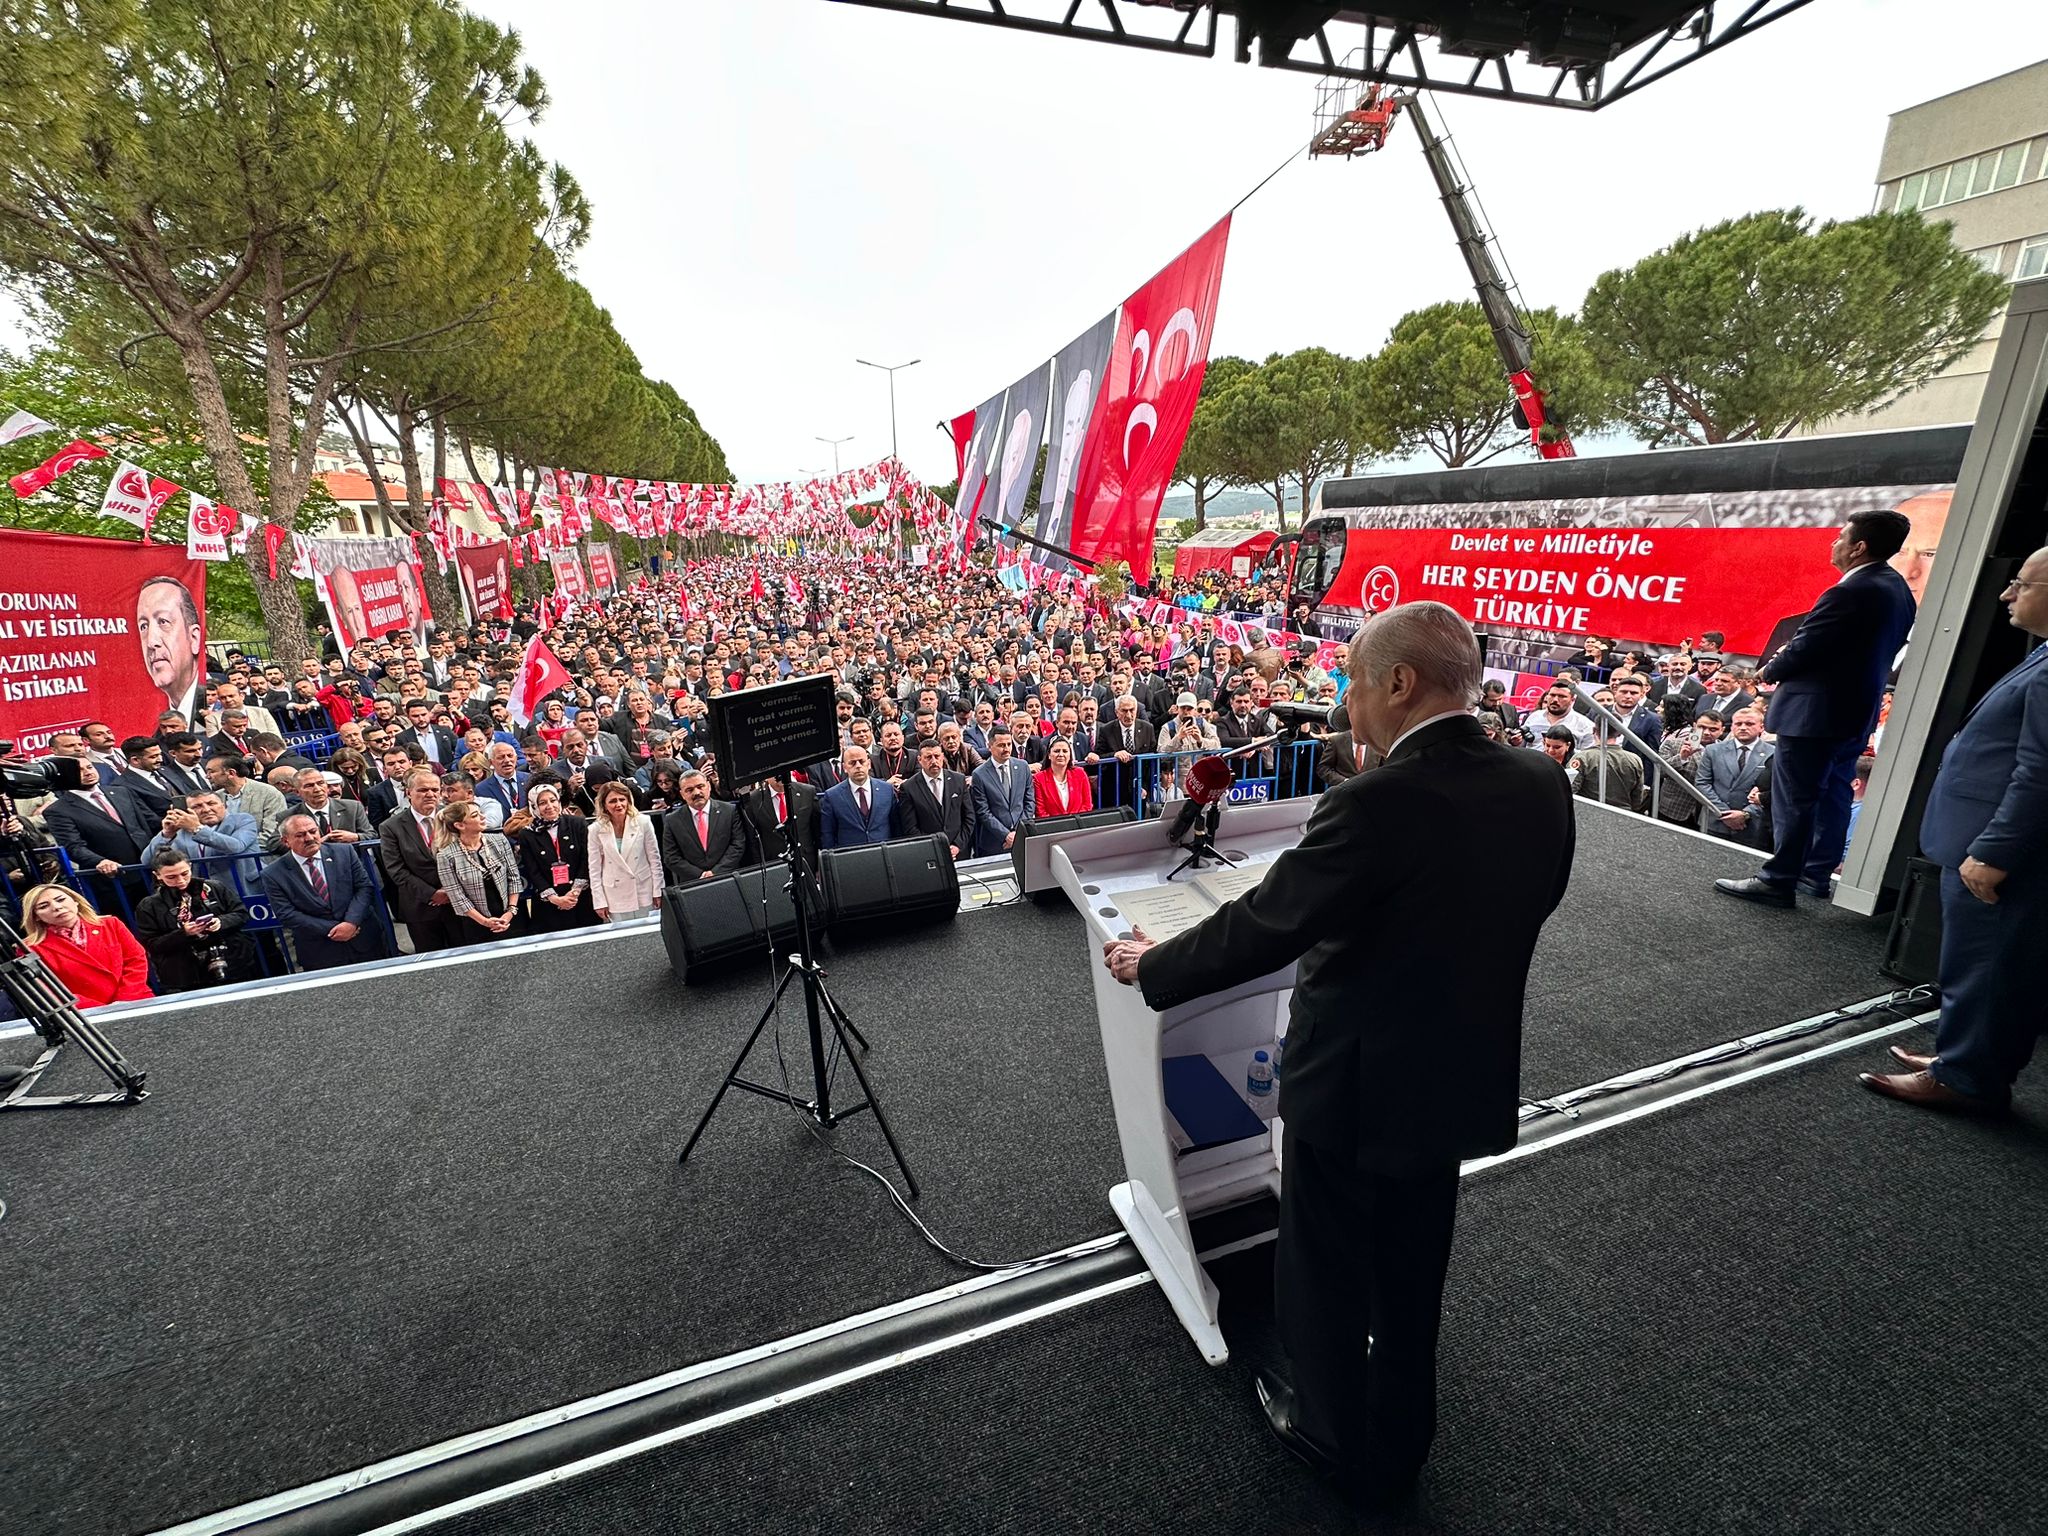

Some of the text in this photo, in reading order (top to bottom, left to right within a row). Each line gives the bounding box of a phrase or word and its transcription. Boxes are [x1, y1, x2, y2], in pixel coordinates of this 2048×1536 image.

[105, 500, 142, 515] MHP
[195, 543, 225, 553] MHP
[1450, 533, 1654, 561] Devlet ve Milletiyle
[1422, 564, 1687, 603] HER ŞEYDEN ÖNCE
[20, 619, 47, 637] VE
[51, 613, 128, 637] İSTİKRAR
[1473, 594, 1591, 631] TÜRKİYE
[2, 675, 88, 702] İSTİKBAL
